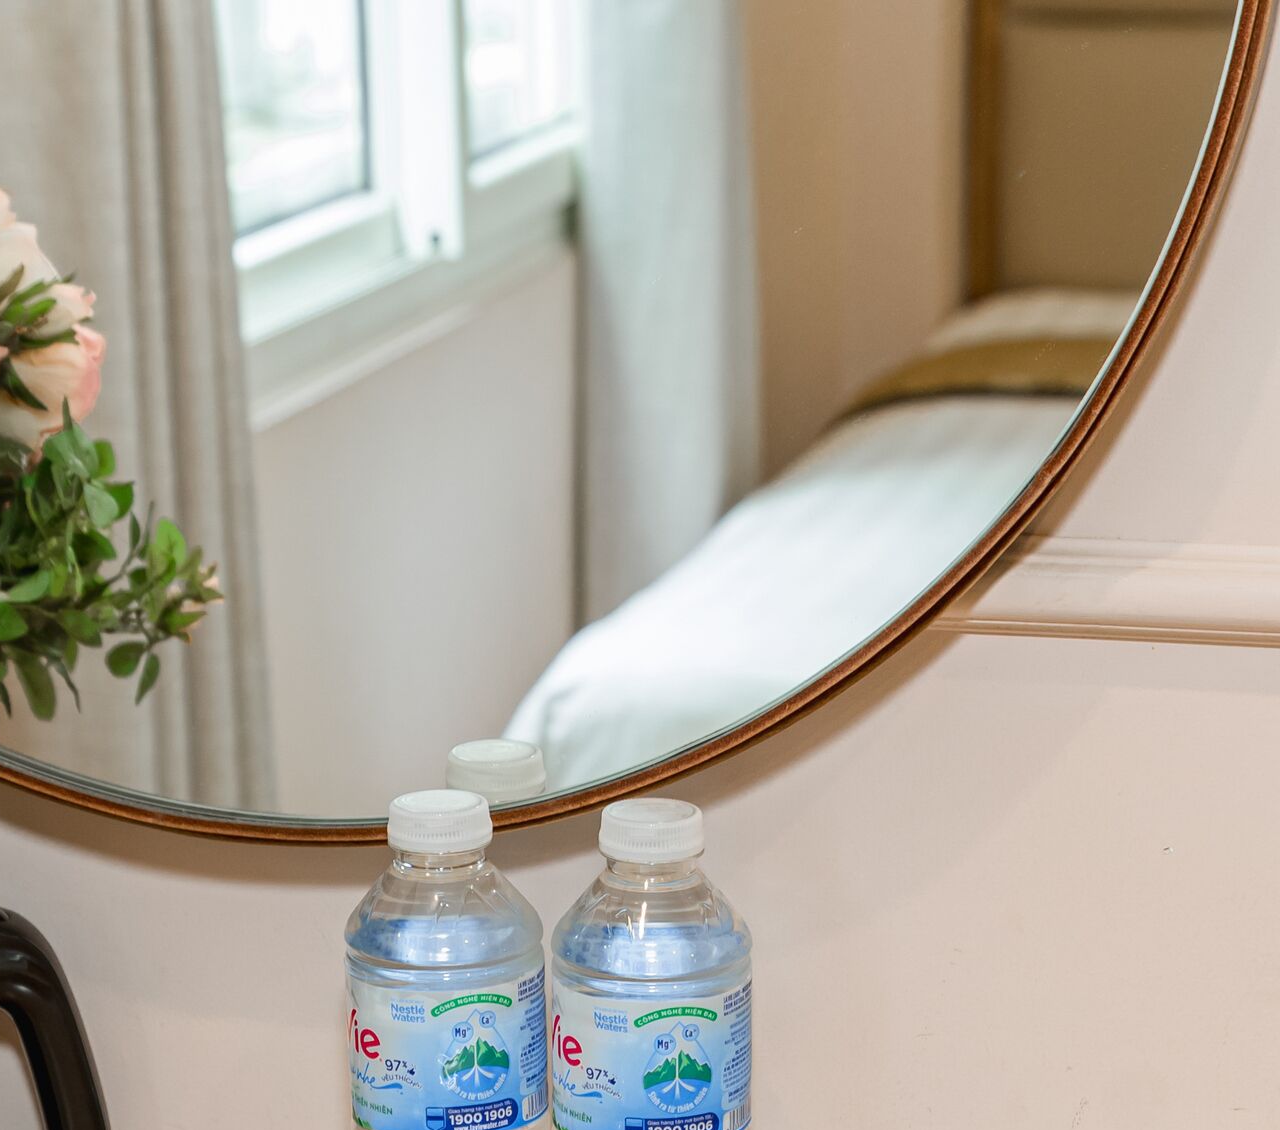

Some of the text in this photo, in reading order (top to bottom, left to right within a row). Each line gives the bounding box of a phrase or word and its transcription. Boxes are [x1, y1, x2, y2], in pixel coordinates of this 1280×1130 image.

[390, 1002, 425, 1015] Nestlé
[434, 1001, 456, 1015] CÔNG
[391, 1013, 426, 1024] Waters
[593, 1011, 628, 1025] Nestlé
[638, 1013, 659, 1026] CÔNG
[594, 1021, 628, 1033] Waters
[384, 1059, 408, 1073] 97%
[585, 1067, 609, 1081] 97%
[449, 1105, 513, 1126] 1900 1906
